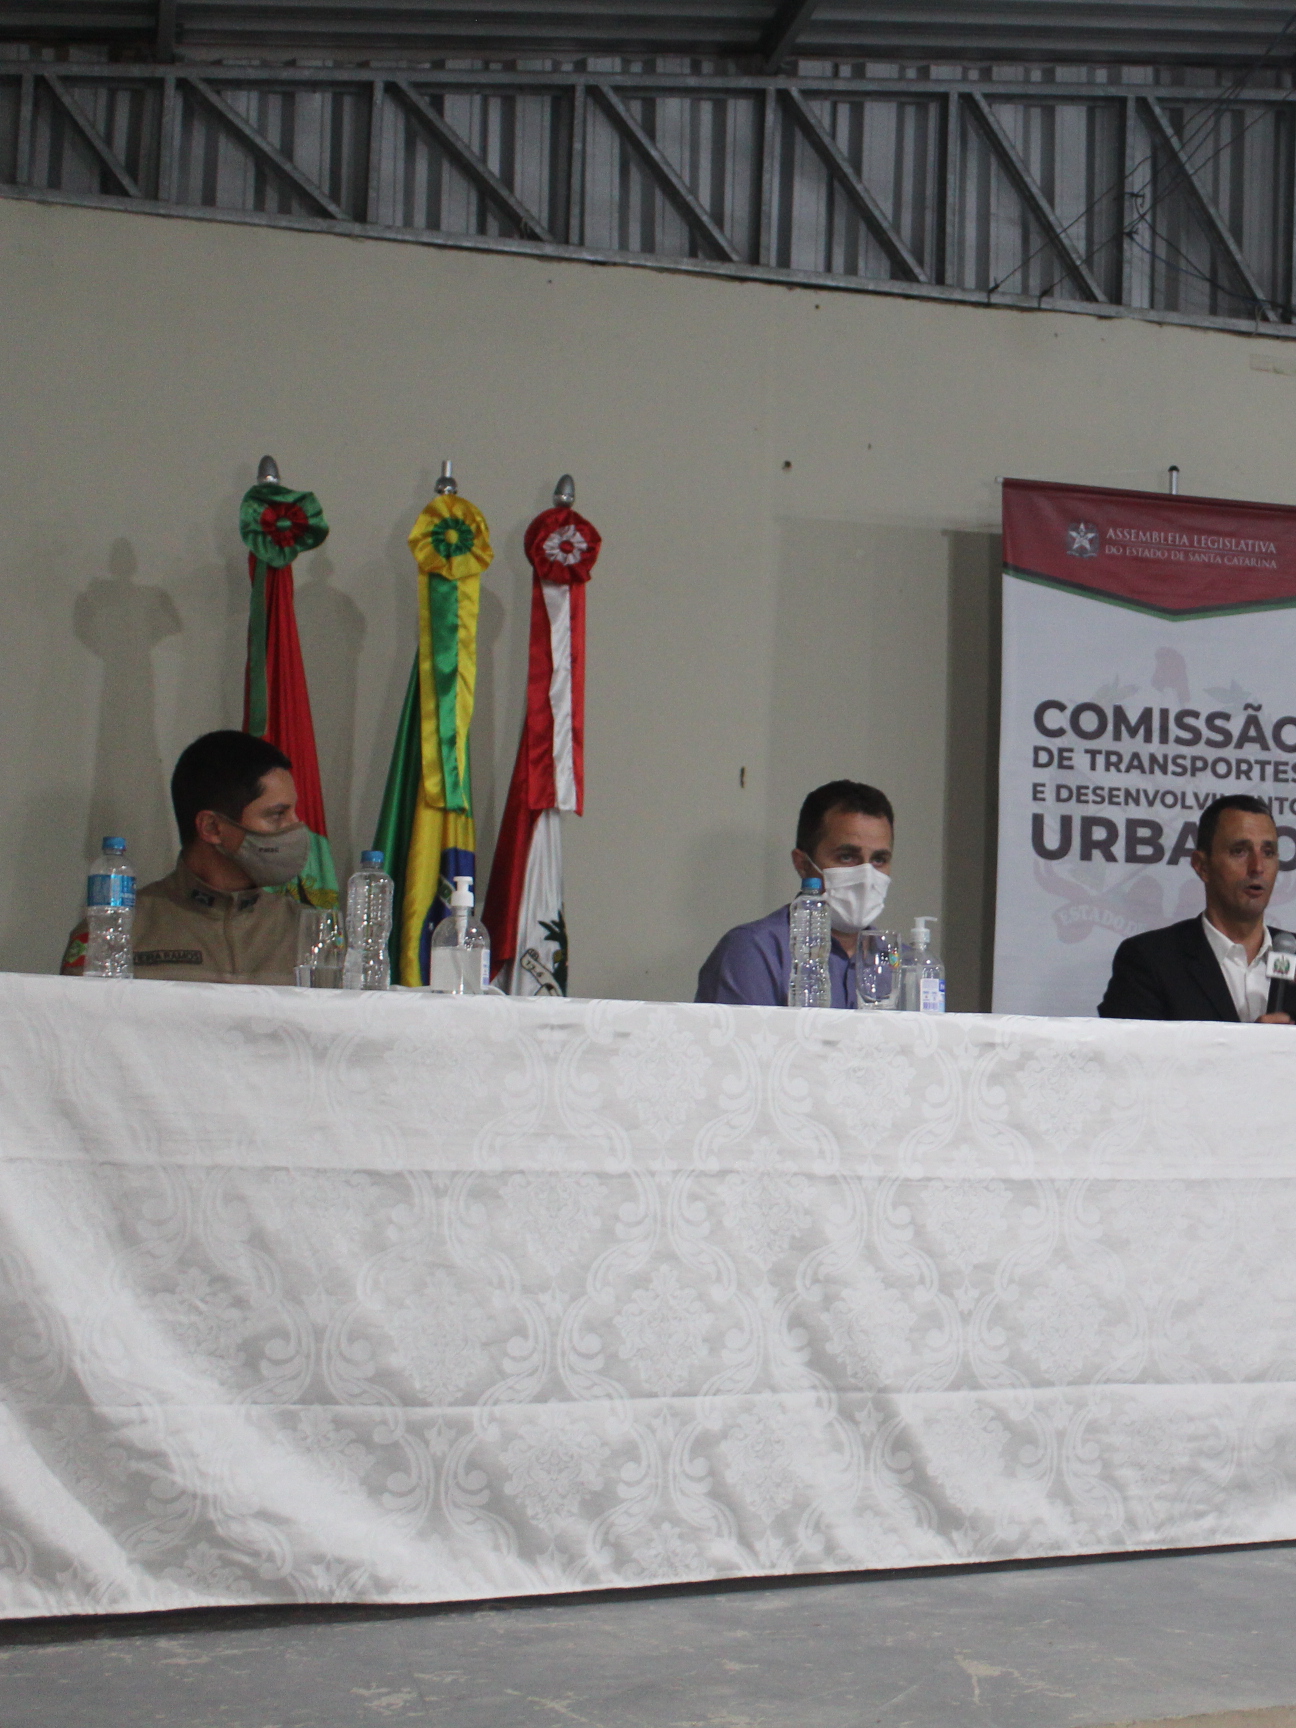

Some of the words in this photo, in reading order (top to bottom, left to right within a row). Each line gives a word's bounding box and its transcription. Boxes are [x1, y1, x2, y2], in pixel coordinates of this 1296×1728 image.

[1106, 527, 1189, 546] ASSEMBLEIA
[1193, 534, 1277, 554] LEGISLATIVA
[1105, 544, 1123, 555] DO
[1126, 546, 1168, 560] ESTADO
[1171, 550, 1186, 561] DE
[1188, 552, 1222, 564] SANTA
[1224, 555, 1277, 569] CATARINA
[1032, 745, 1074, 770] DE
[1031, 782, 1047, 802] E
